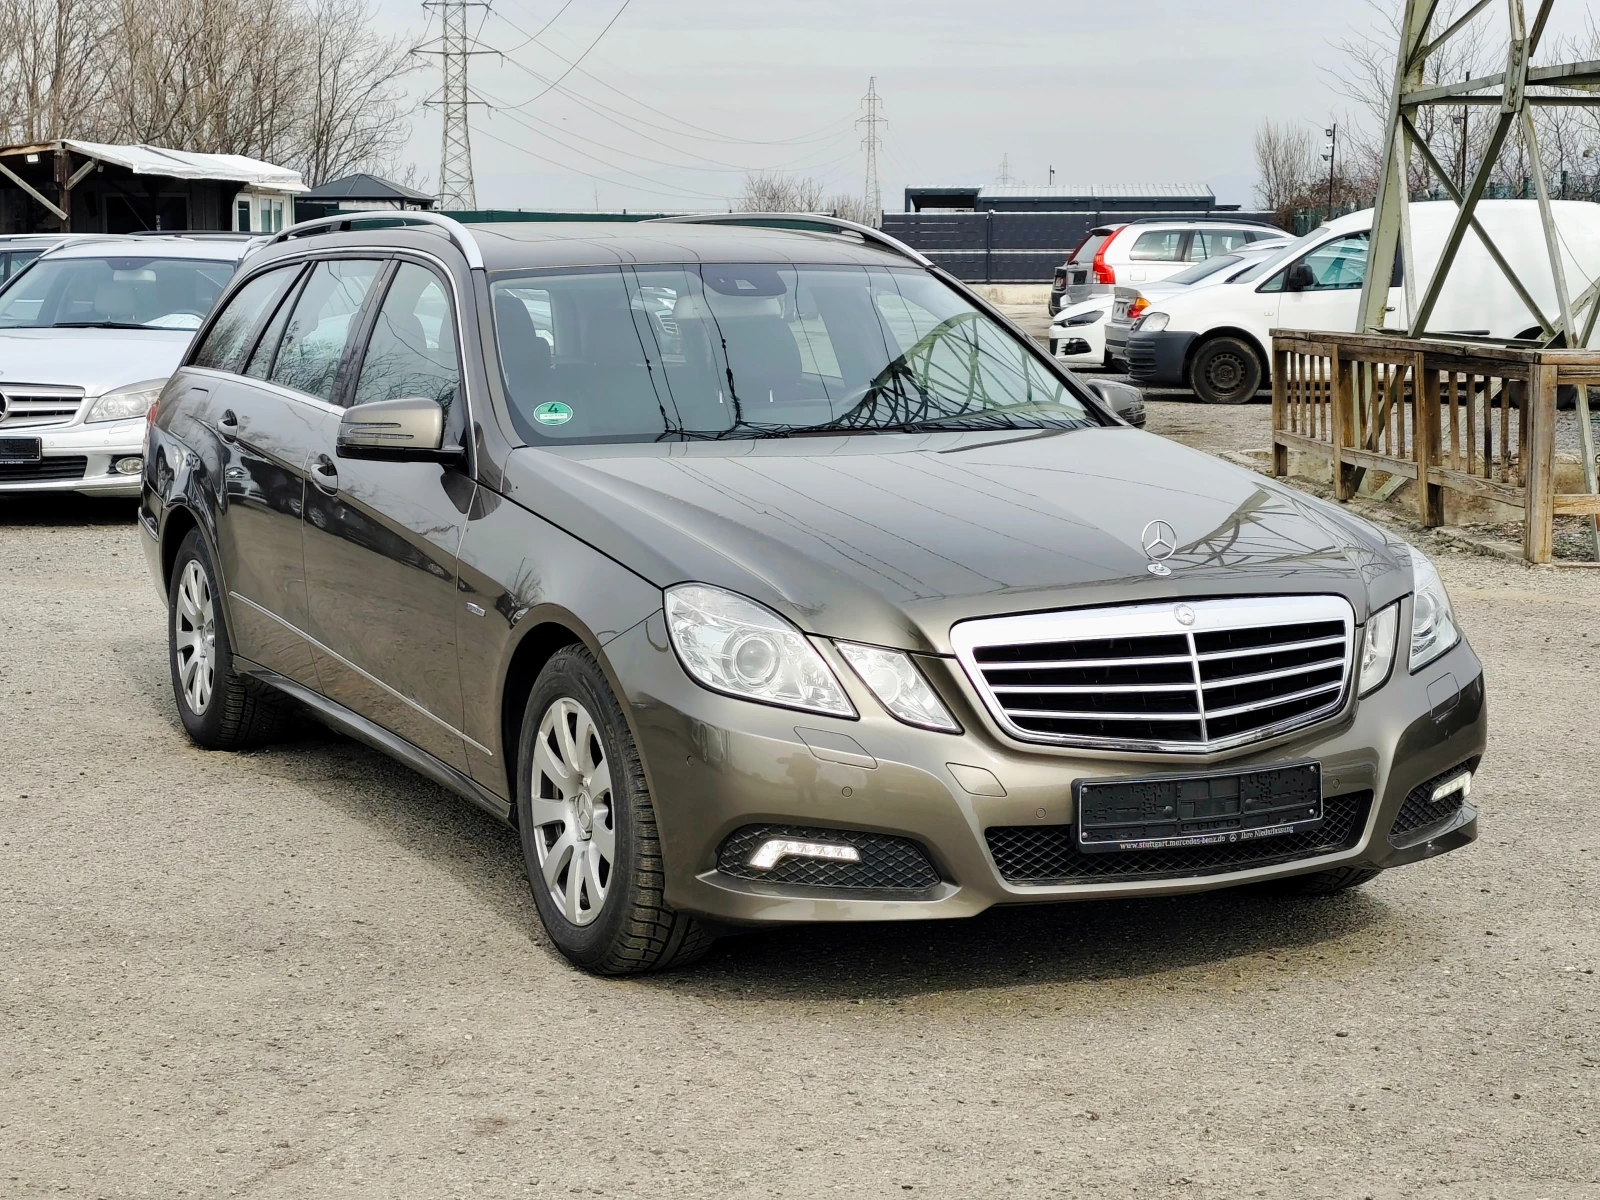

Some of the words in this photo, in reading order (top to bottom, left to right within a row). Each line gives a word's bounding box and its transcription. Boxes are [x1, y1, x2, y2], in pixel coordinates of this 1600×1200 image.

[548, 403, 559, 413] 4
[1119, 835, 1226, 849] www.stuttgart.mercedes-benz.de
[1241, 831, 1253, 839] Ihre
[1254, 825, 1294, 838] Niederlassung
